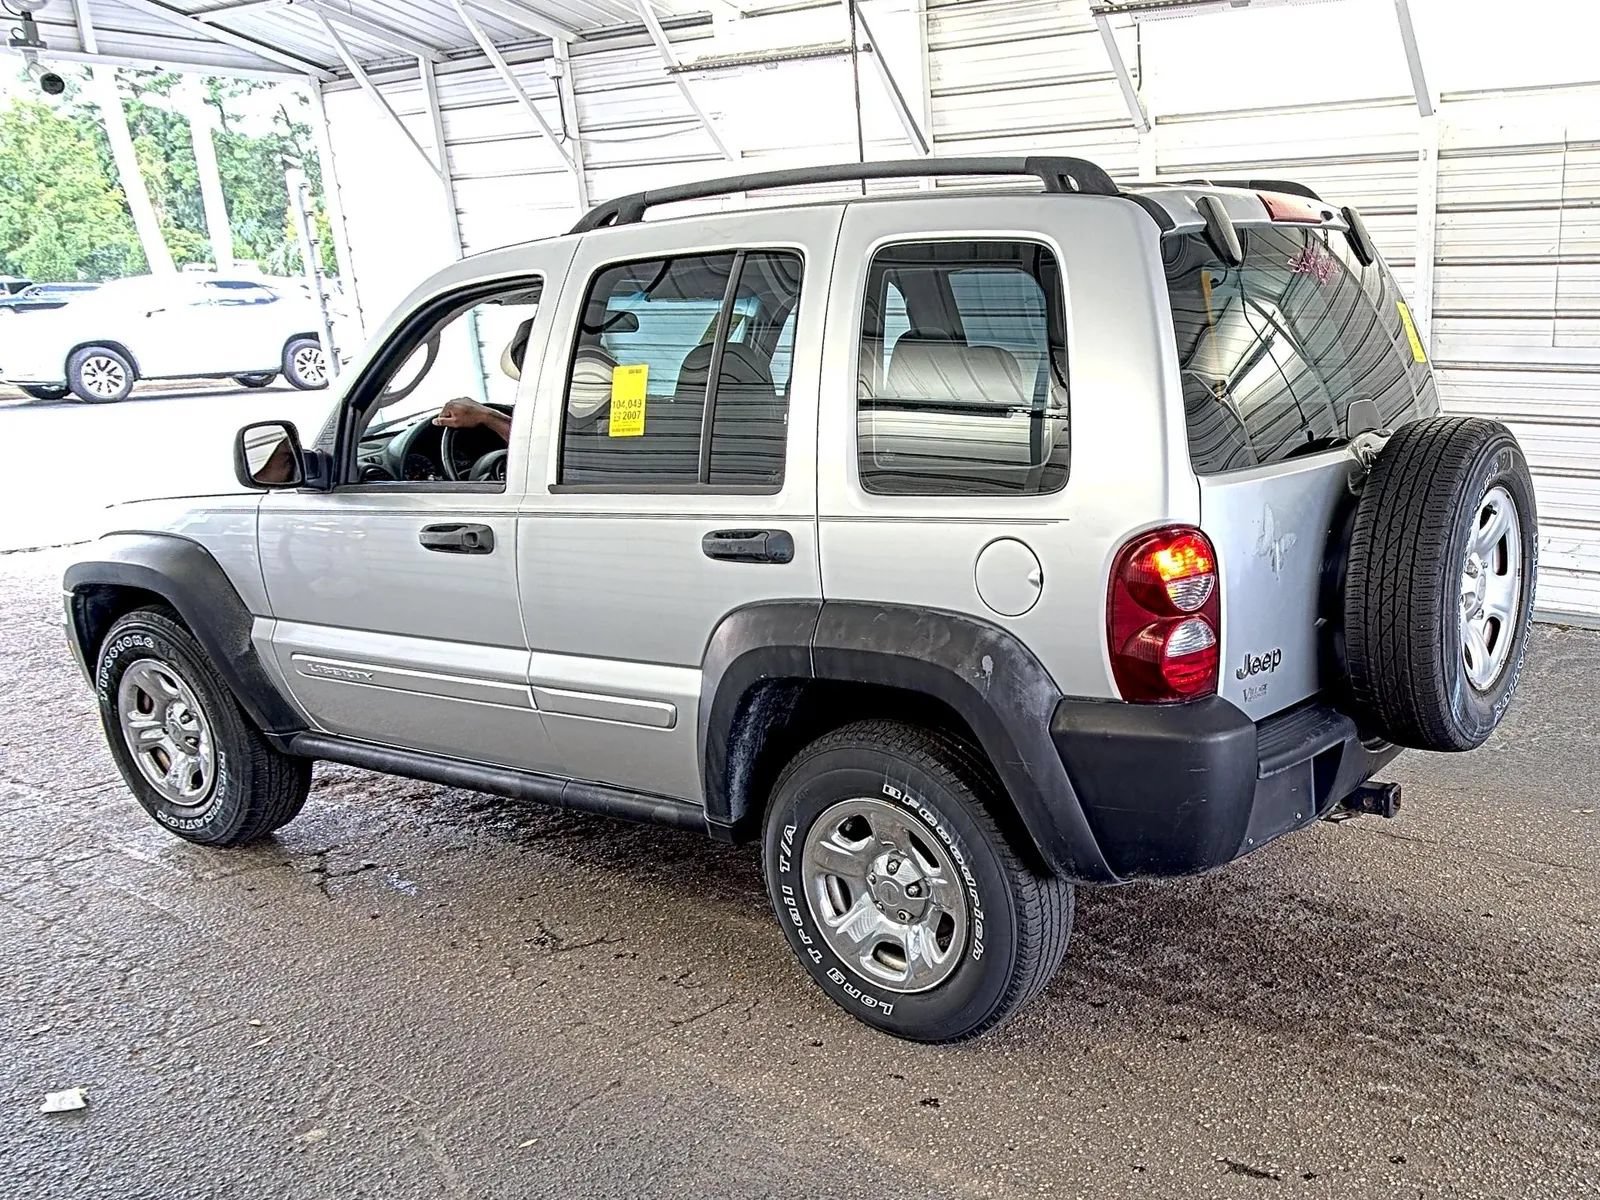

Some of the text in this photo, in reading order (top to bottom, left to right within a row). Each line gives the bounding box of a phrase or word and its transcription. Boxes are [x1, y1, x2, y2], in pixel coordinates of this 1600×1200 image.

[622, 411, 641, 420] 2007
[307, 663, 374, 681] LIBERTY
[1235, 648, 1282, 680] Jeep
[779, 825, 894, 1016] Long Trail T/A
